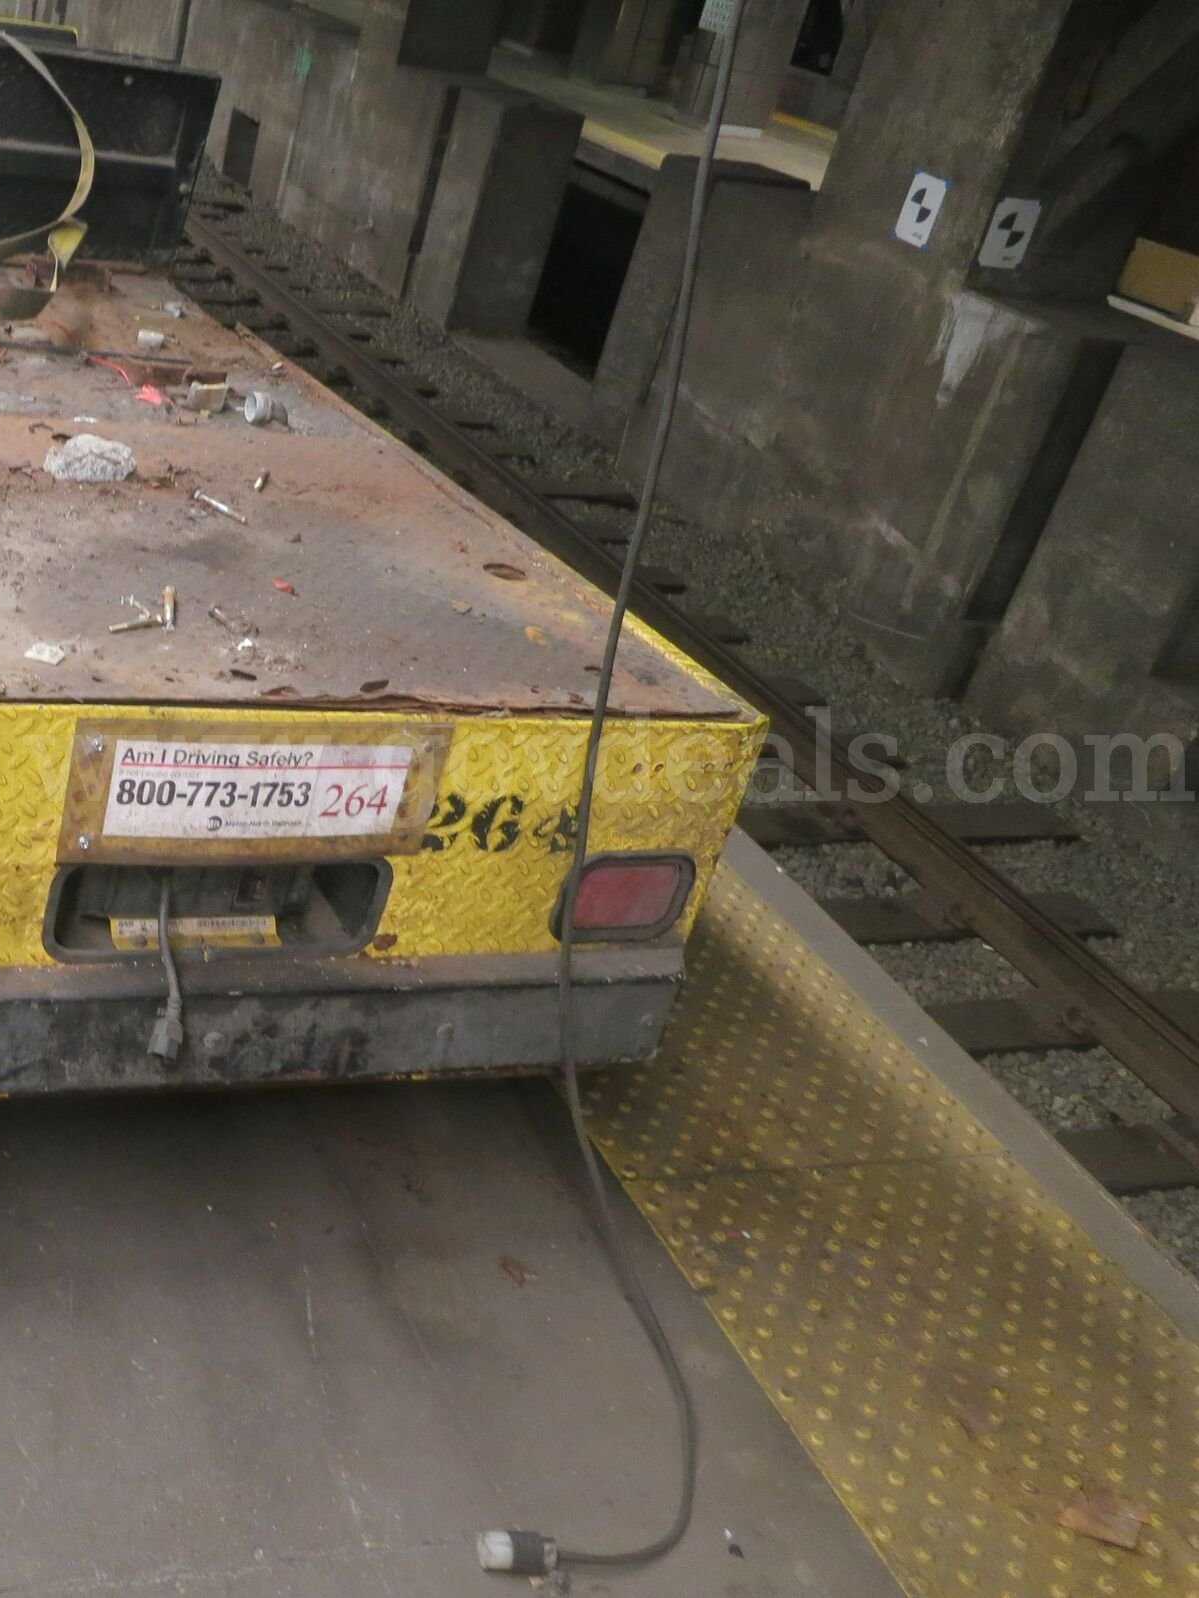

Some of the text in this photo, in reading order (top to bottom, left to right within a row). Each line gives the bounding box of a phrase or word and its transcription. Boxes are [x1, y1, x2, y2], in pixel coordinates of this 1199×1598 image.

[122, 748, 314, 767] Am I Driving Safely?
[116, 779, 312, 809] 800-773-1753
[318, 784, 389, 817] 264
